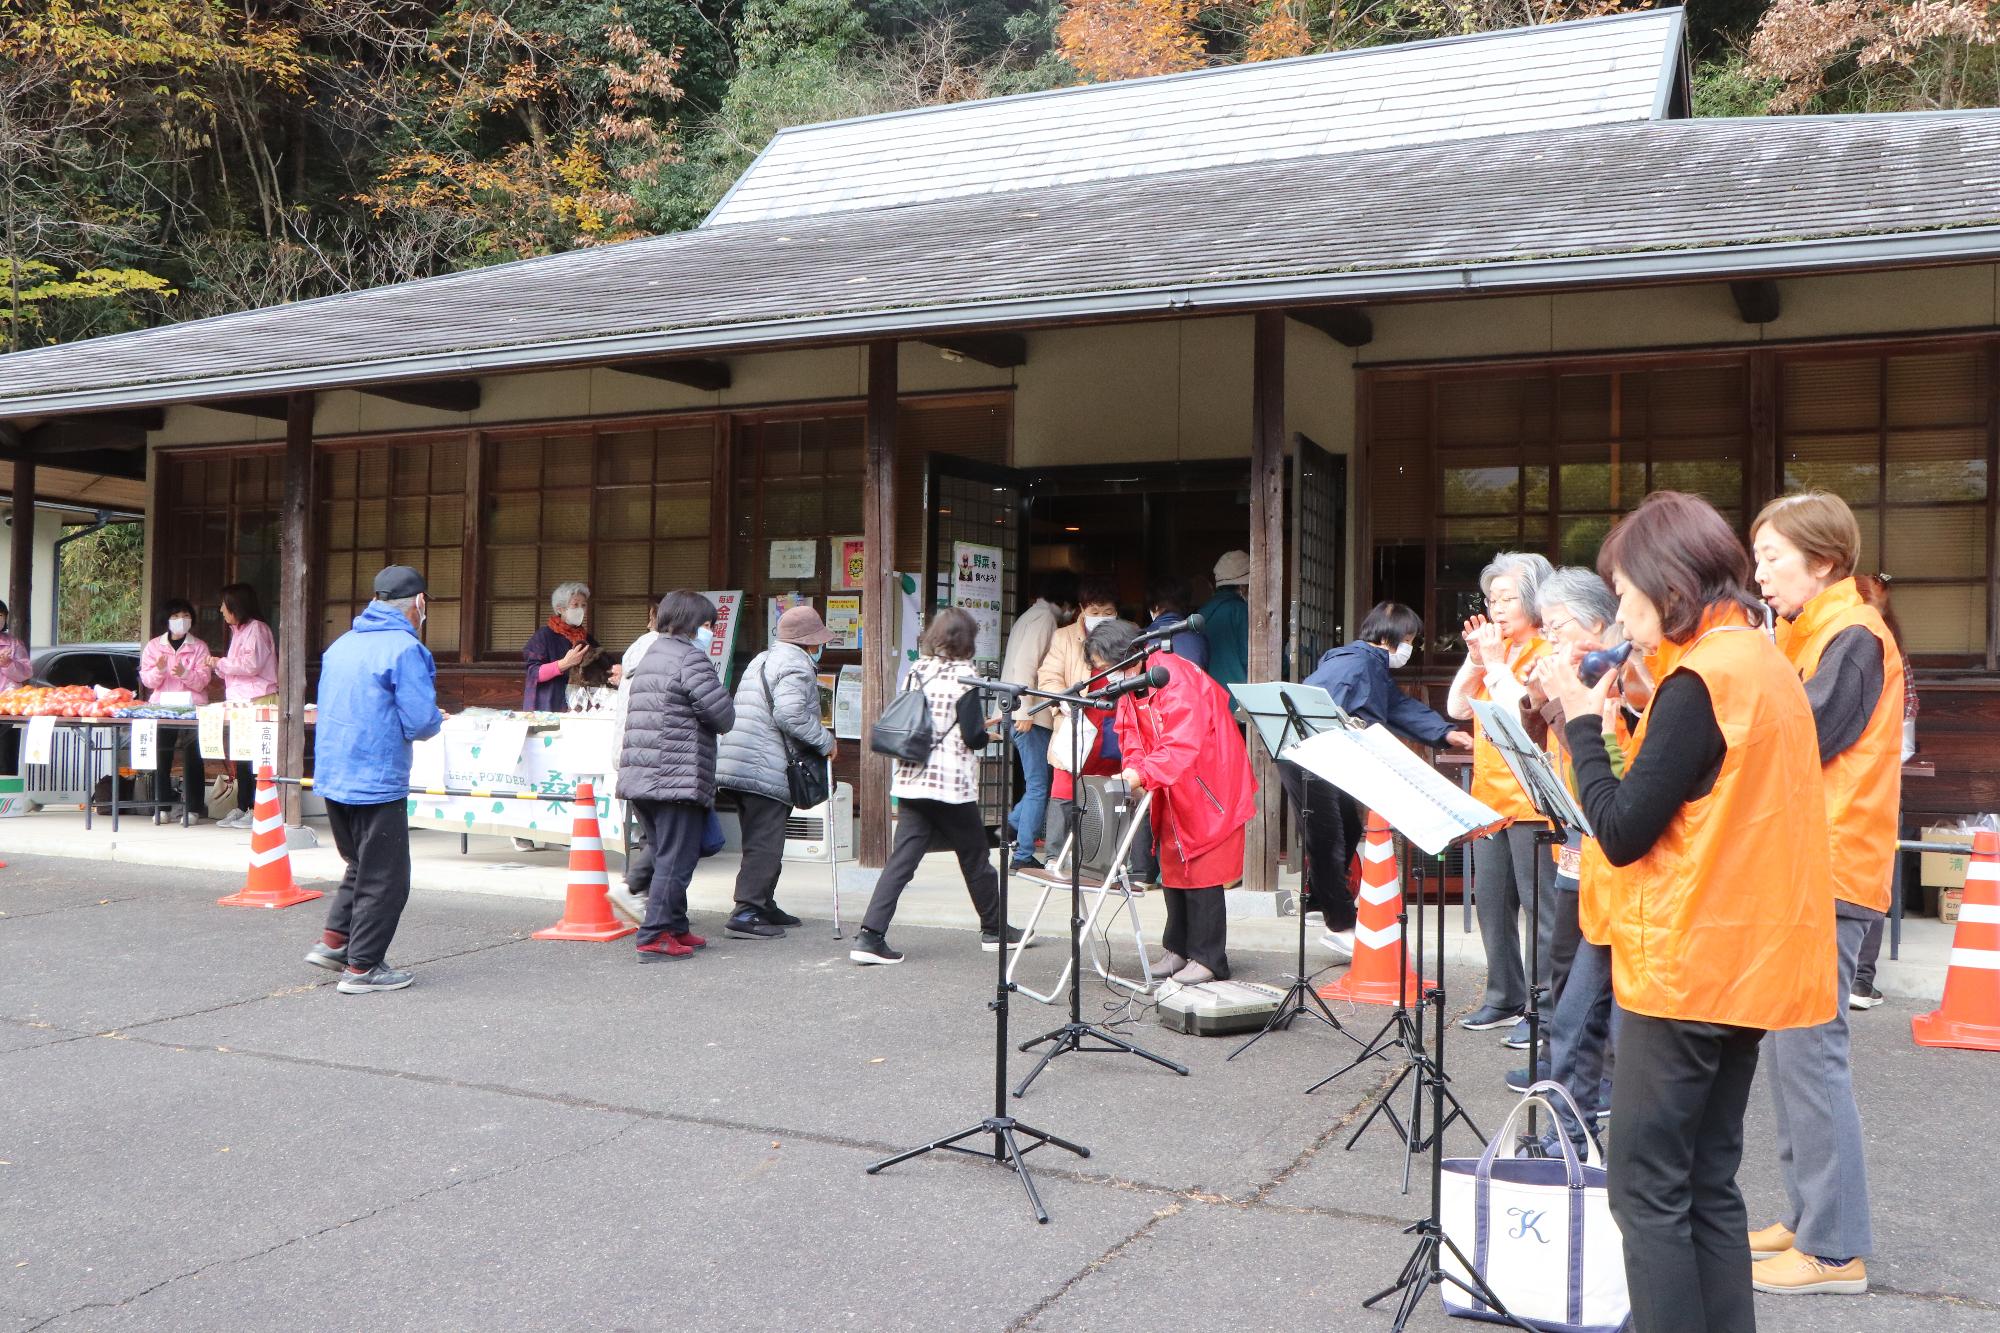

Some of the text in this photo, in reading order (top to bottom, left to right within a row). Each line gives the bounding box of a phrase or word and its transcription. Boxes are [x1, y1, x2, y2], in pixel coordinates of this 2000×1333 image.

[719, 595, 734, 603] 毎週
[710, 605, 731, 656] 金曜日
[479, 771, 527, 786] POWDER
[1507, 1207, 1550, 1243] K
